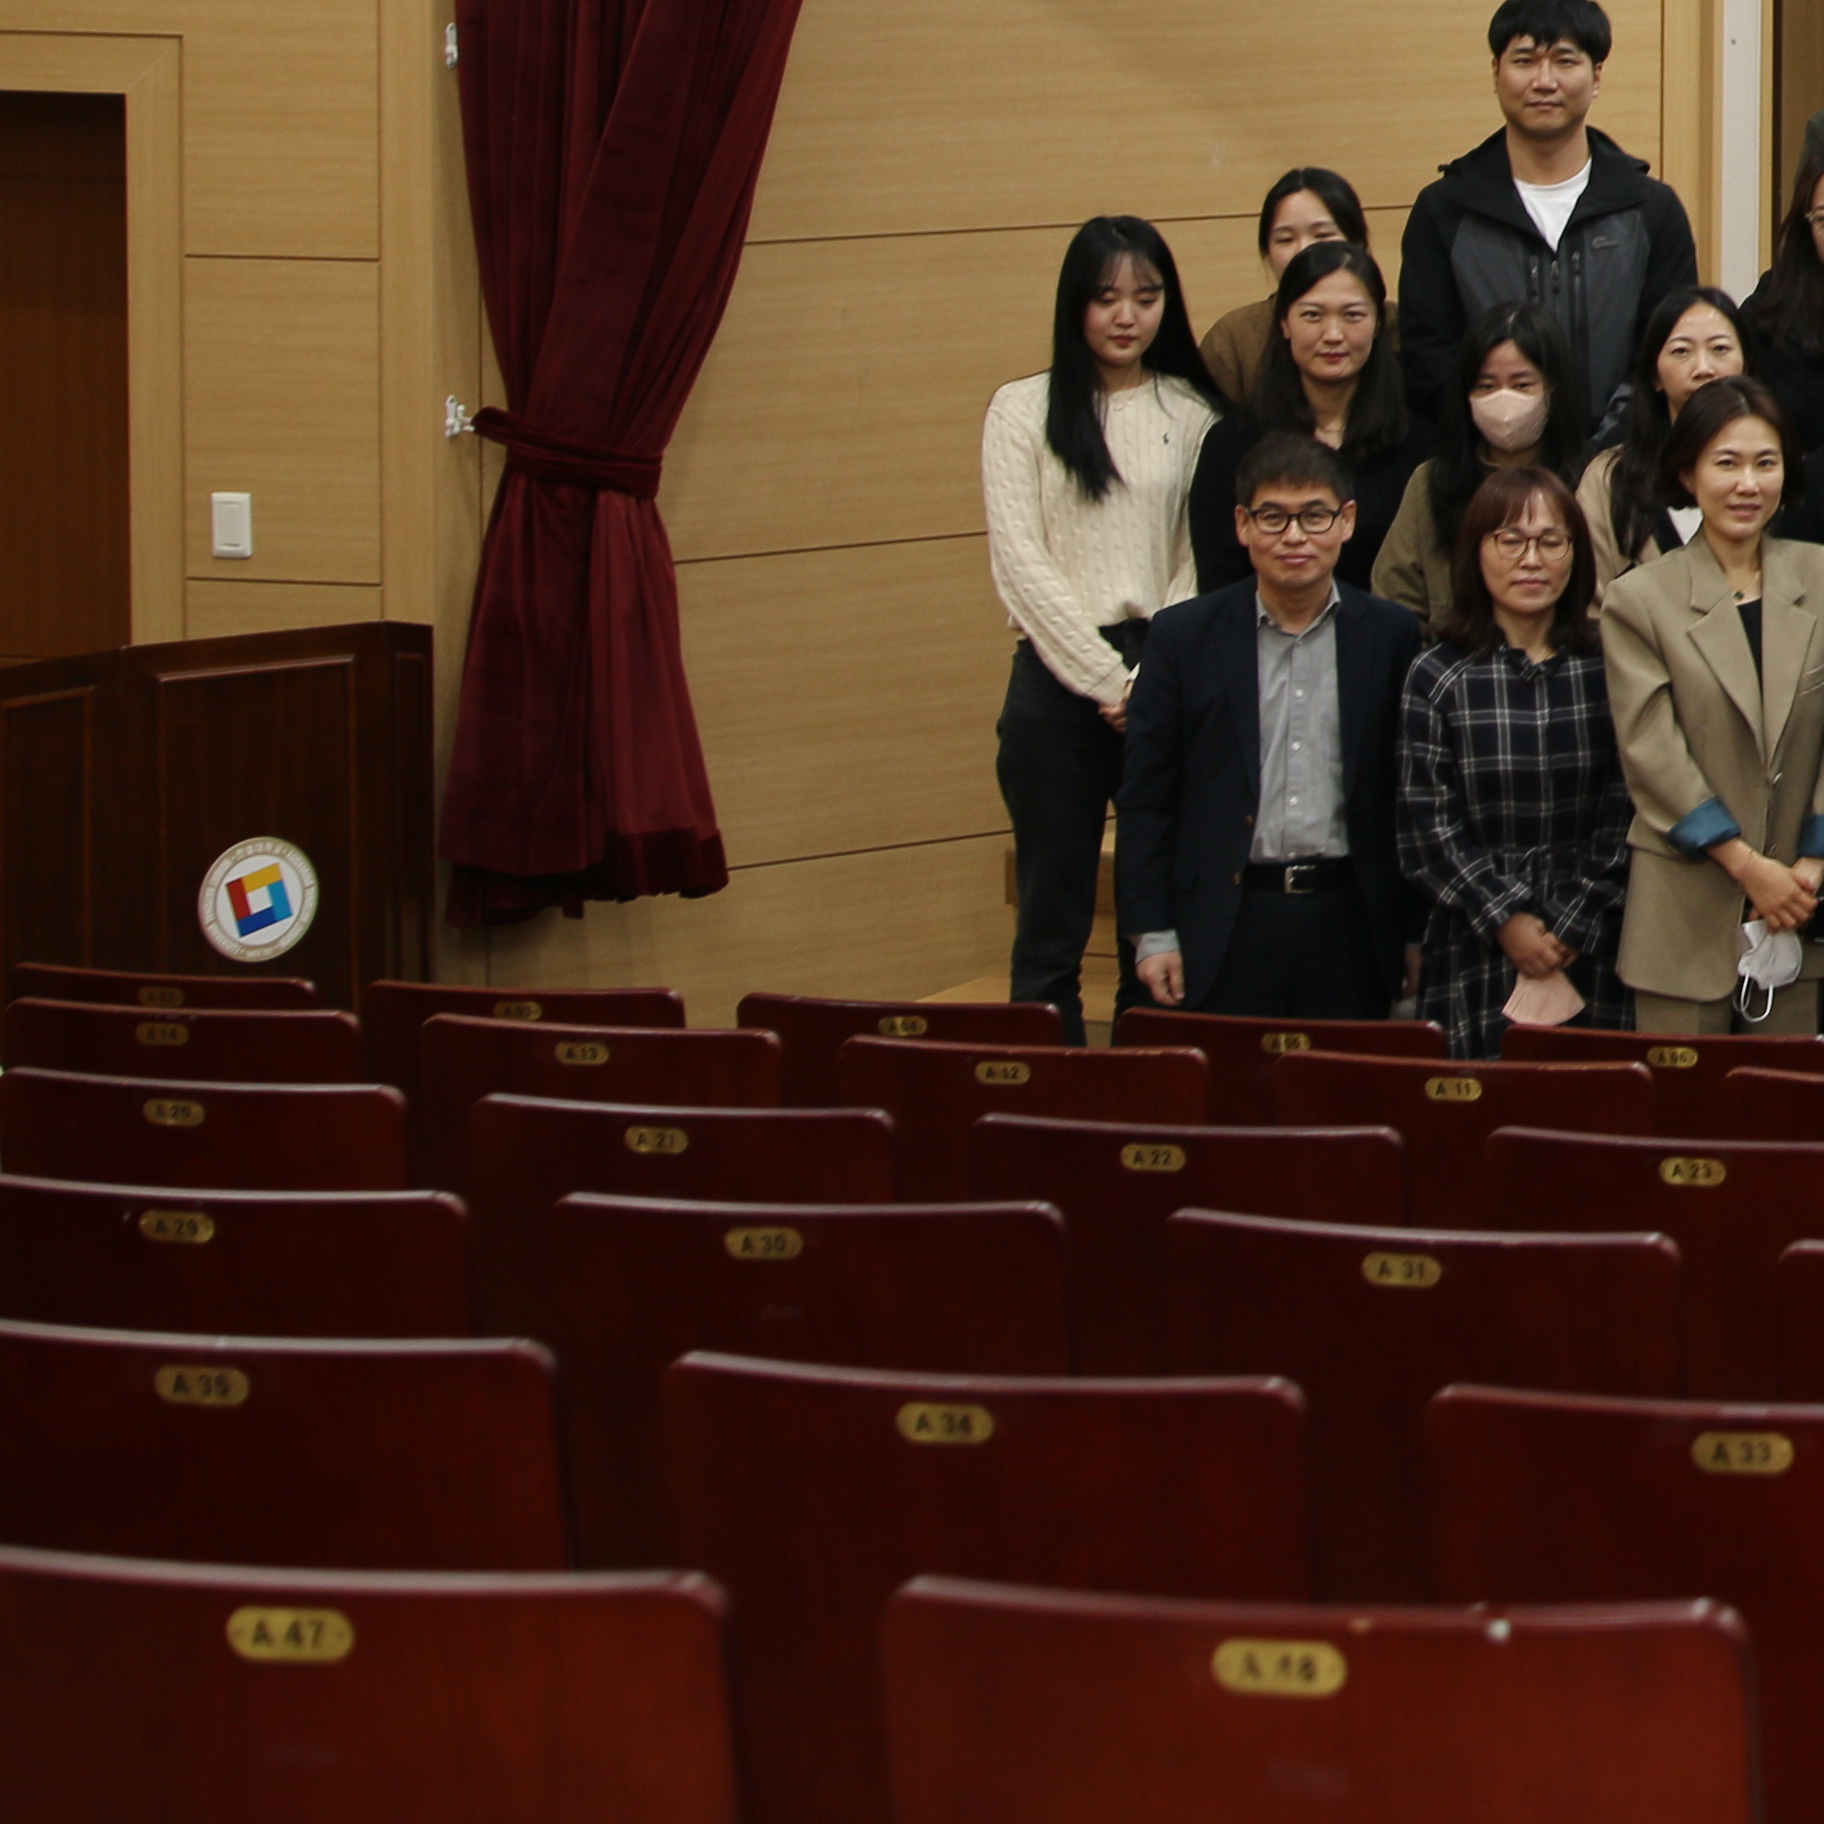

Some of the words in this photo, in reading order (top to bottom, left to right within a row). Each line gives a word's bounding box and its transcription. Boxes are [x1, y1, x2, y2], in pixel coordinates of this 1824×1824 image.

[1436, 1082, 1446, 1095] A
[1456, 1082, 1470, 1096] 11
[1133, 1151, 1144, 1164] A
[1151, 1151, 1171, 1165] 22
[1671, 1164, 1683, 1177] A
[1689, 1164, 1712, 1178] 23
[155, 1218, 166, 1233] A
[175, 1218, 198, 1233] 29
[742, 1234, 753, 1250] A
[761, 1236, 786, 1253] 30
[1378, 1260, 1391, 1277] A
[1402, 1260, 1424, 1277] 31
[252, 1619, 273, 1646] A
[286, 1621, 323, 1647] 47
